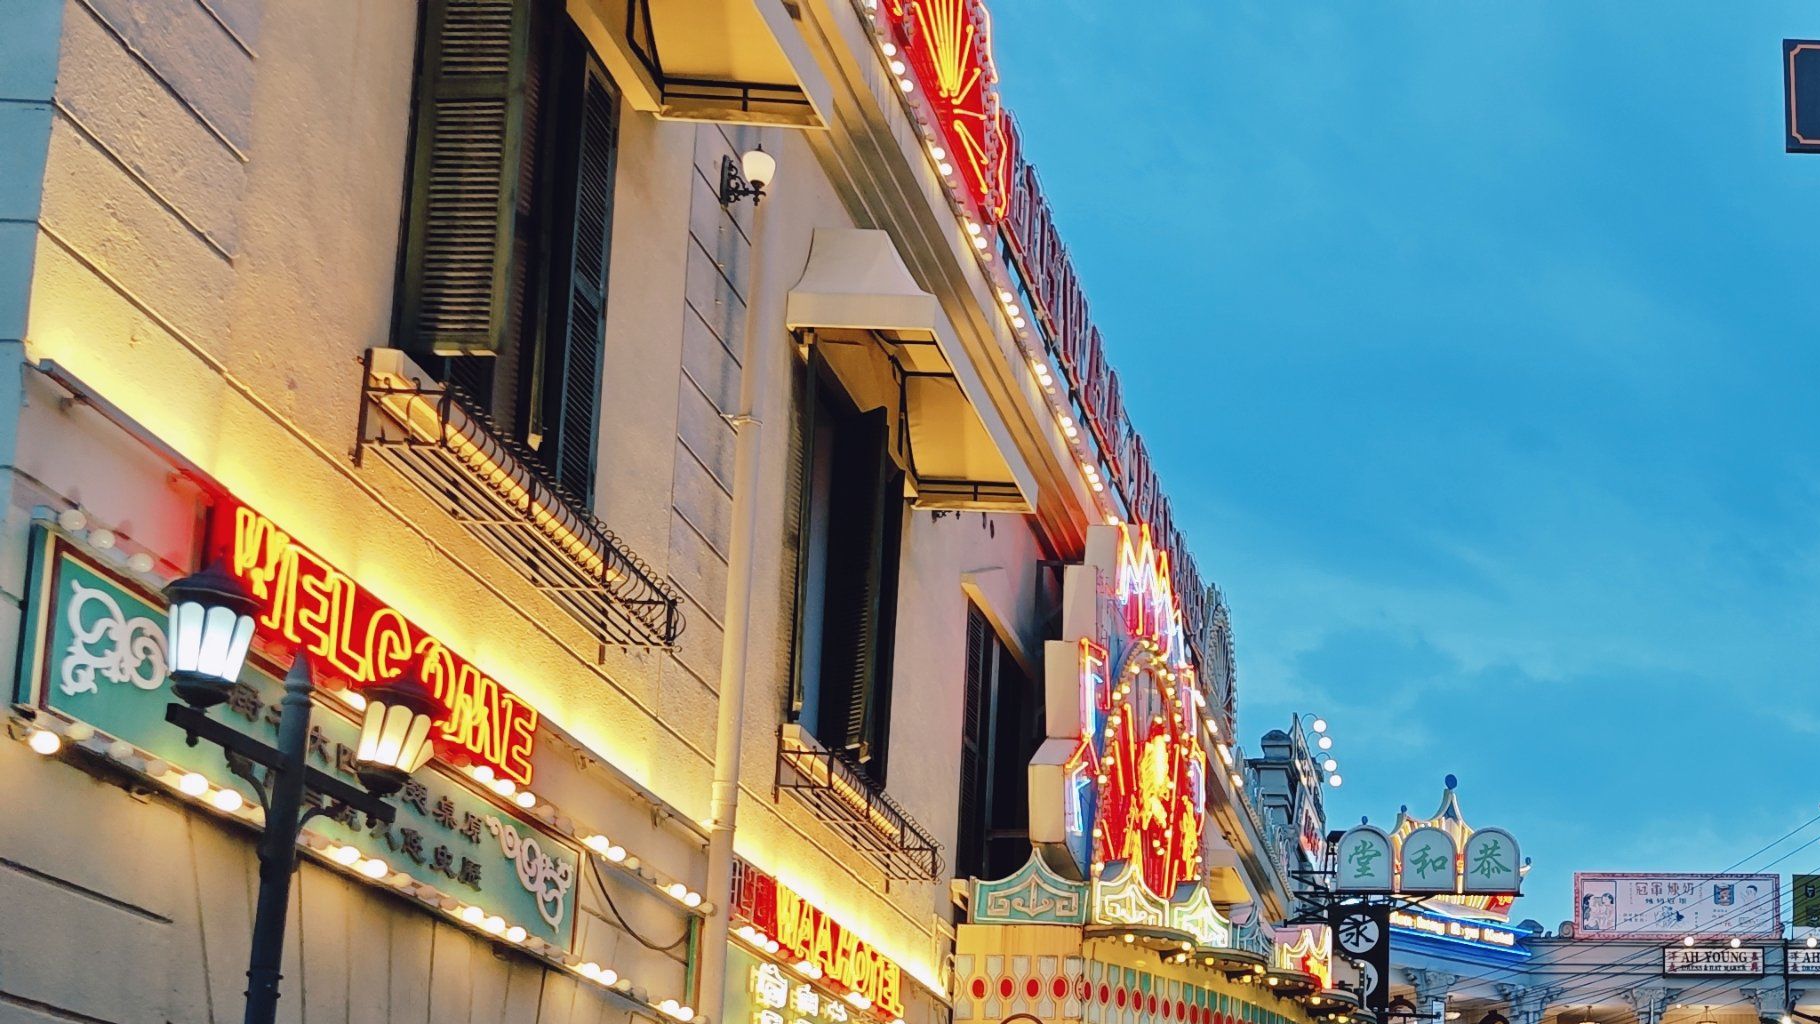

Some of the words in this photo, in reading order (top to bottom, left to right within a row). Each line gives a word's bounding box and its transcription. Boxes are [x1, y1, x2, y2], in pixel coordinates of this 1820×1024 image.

[1681, 951, 1701, 963] AH
[1704, 951, 1748, 963] YOUNG
[1802, 951, 1820, 963] AH
